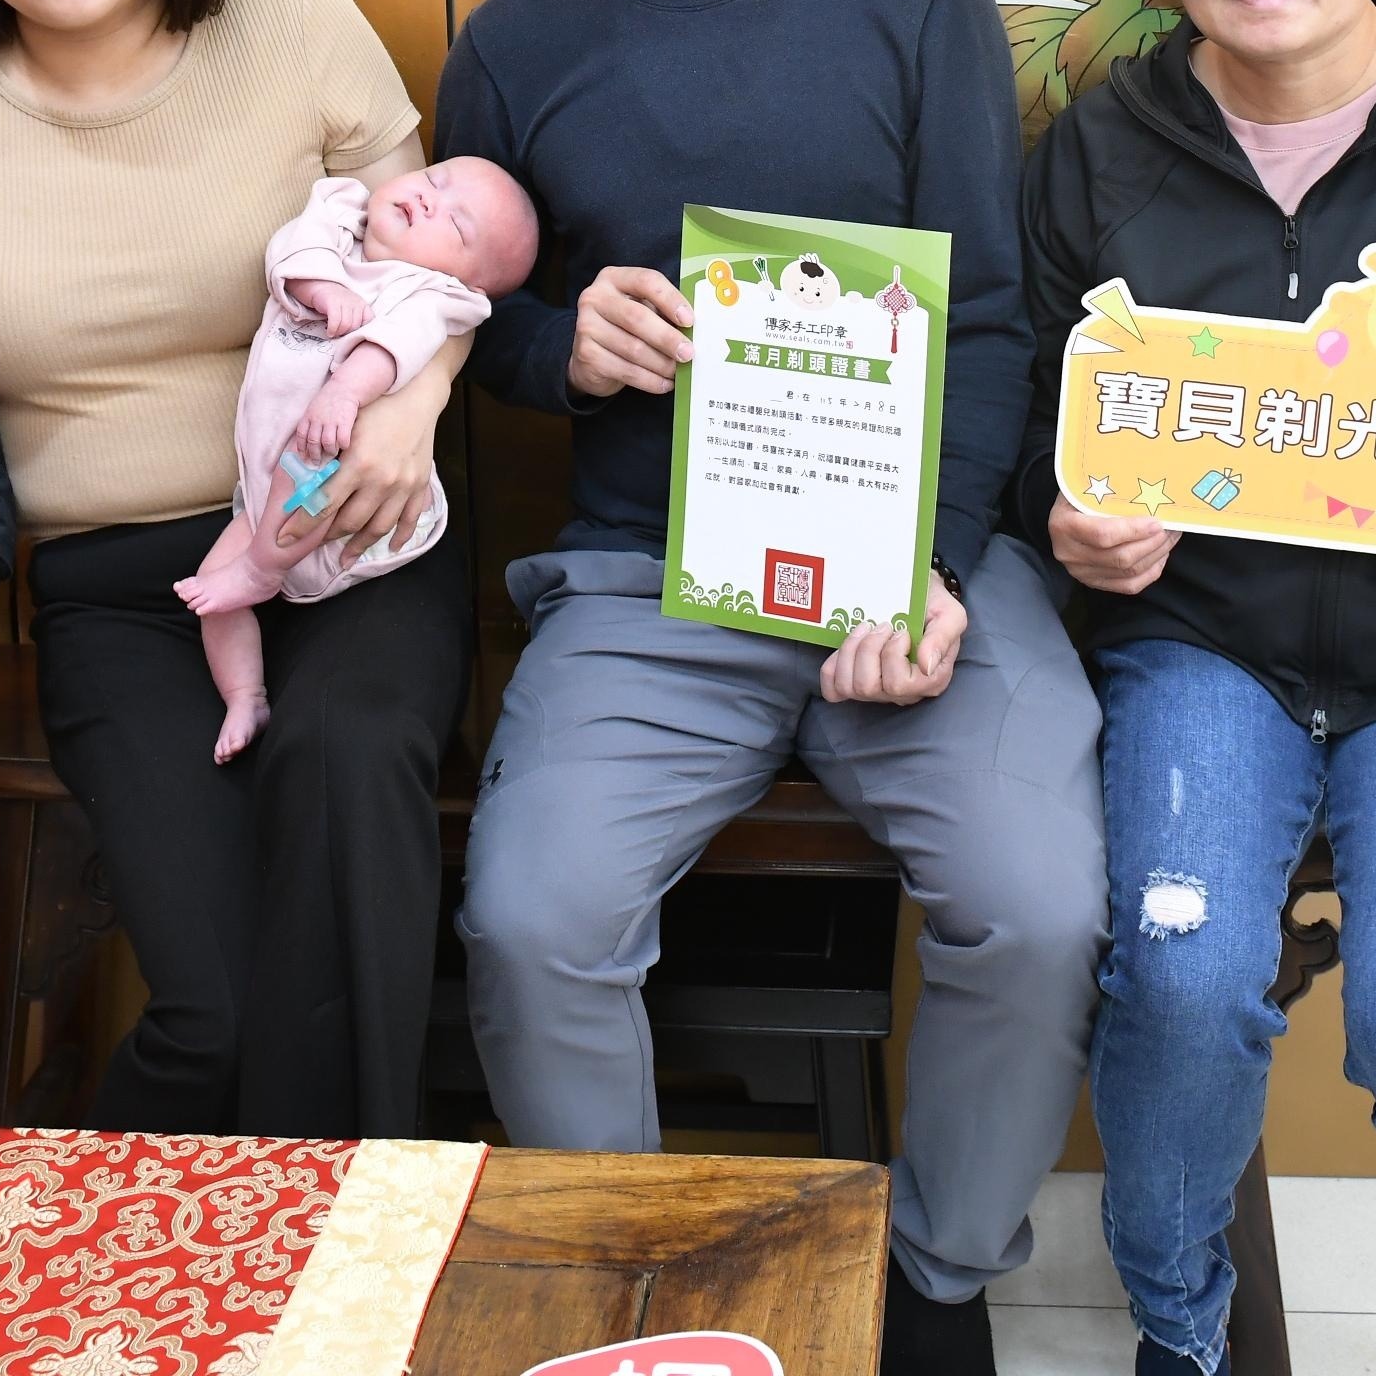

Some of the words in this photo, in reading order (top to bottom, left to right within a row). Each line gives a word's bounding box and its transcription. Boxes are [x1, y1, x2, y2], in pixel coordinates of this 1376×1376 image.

[764, 317, 848, 339] 傳家手工印章
[765, 331, 845, 348] www.seals.com.tw
[743, 343, 871, 380] 滿月剃頭證書
